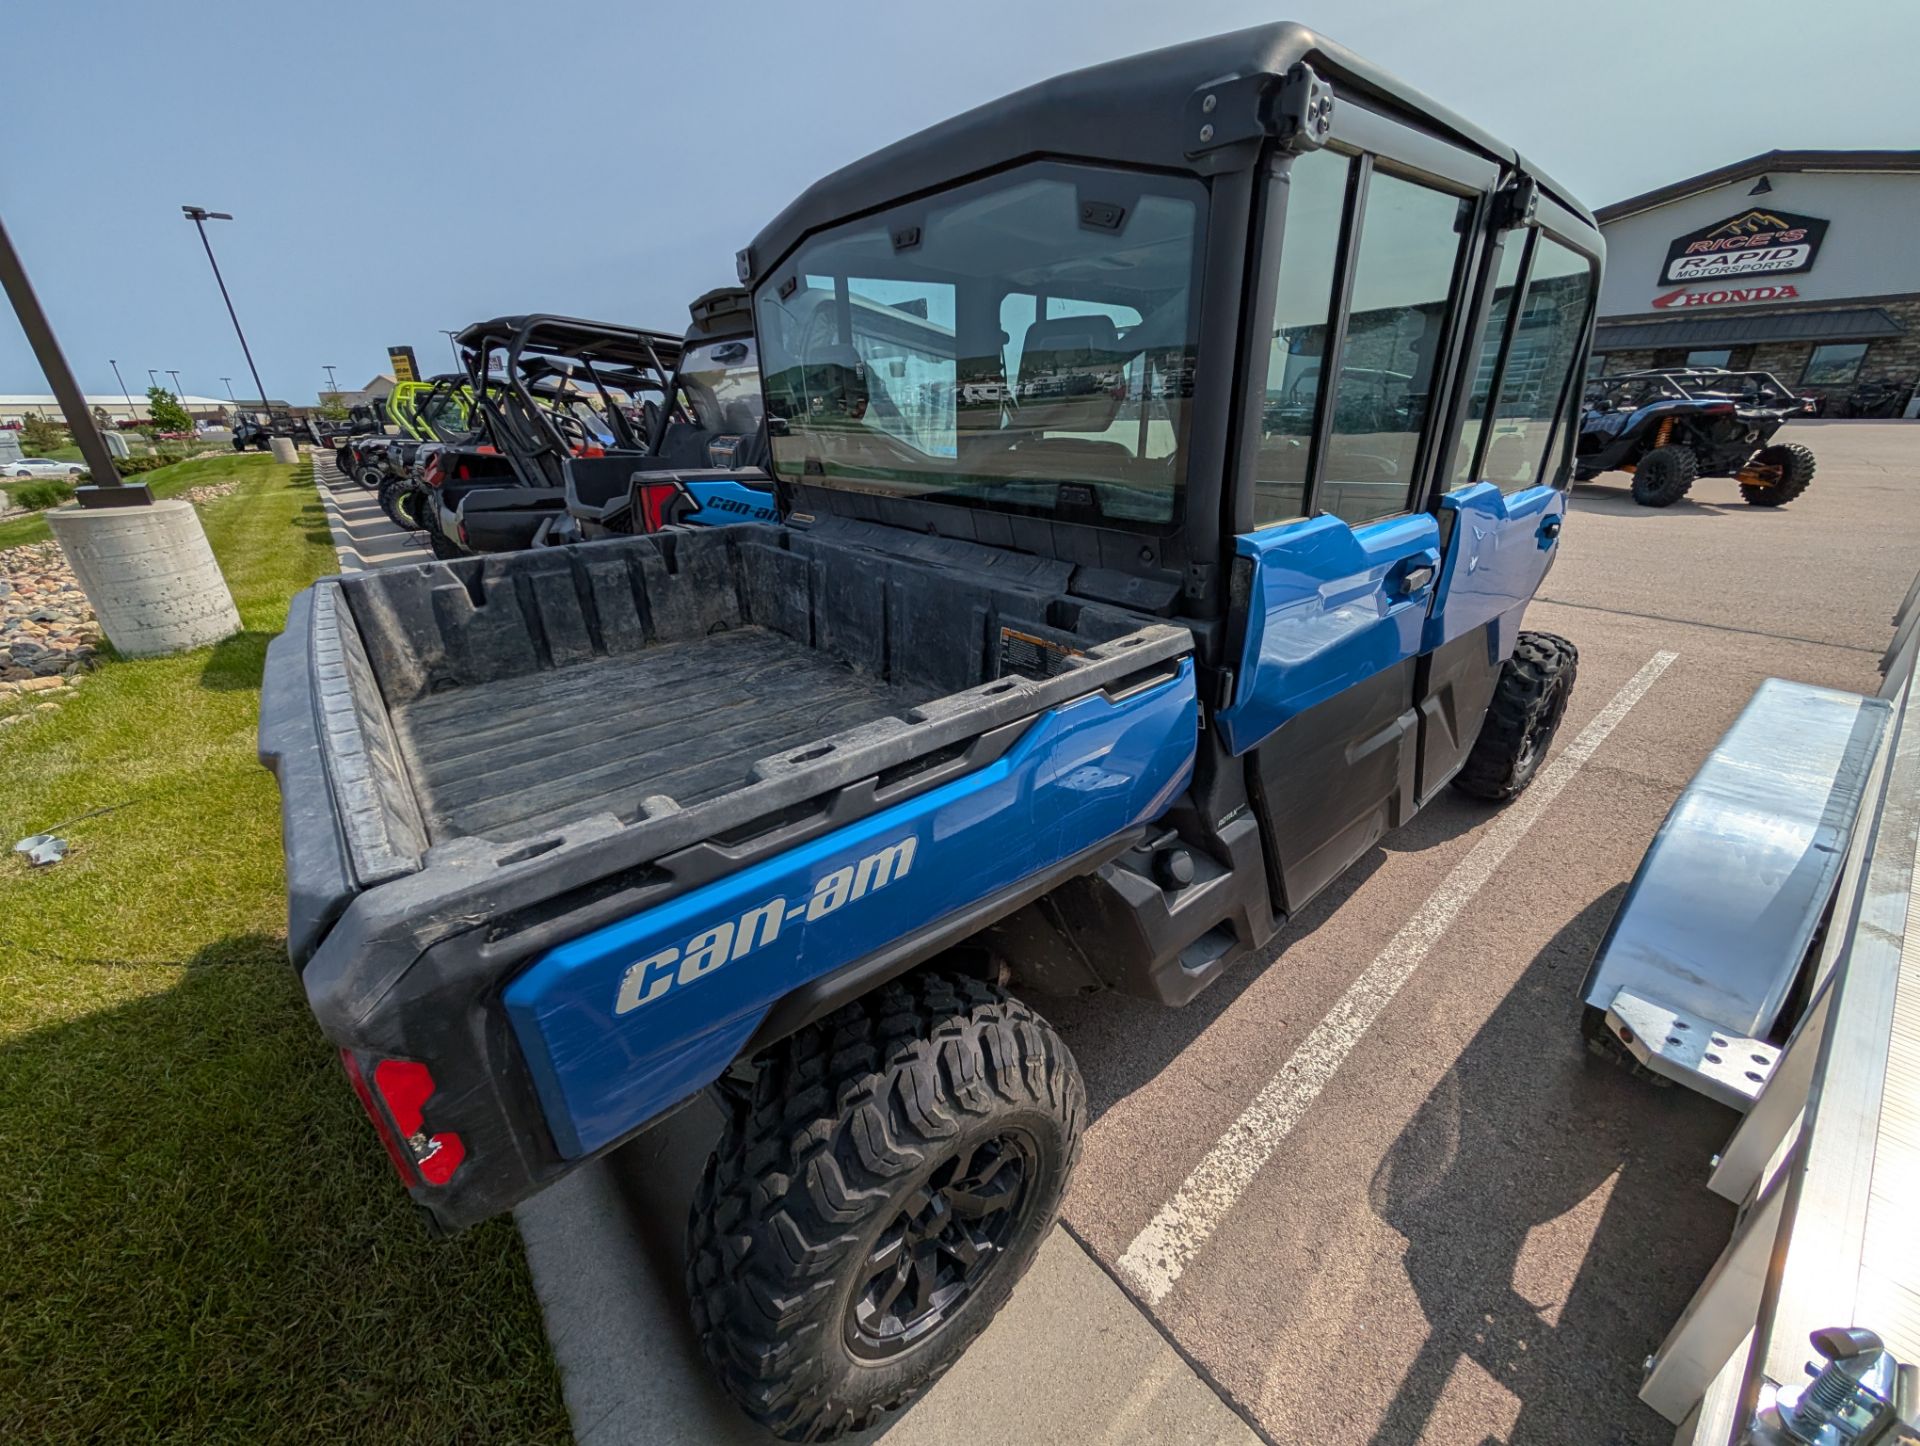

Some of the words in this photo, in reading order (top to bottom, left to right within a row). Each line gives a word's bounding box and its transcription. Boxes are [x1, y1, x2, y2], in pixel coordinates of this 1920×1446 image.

[1685, 228, 1808, 254] RICE'S
[1675, 259, 1795, 279] MOTORSPORTS
[1679, 247, 1799, 270] RAPID
[1681, 284, 1799, 307] HONDA
[615, 837, 917, 1015] can-am
